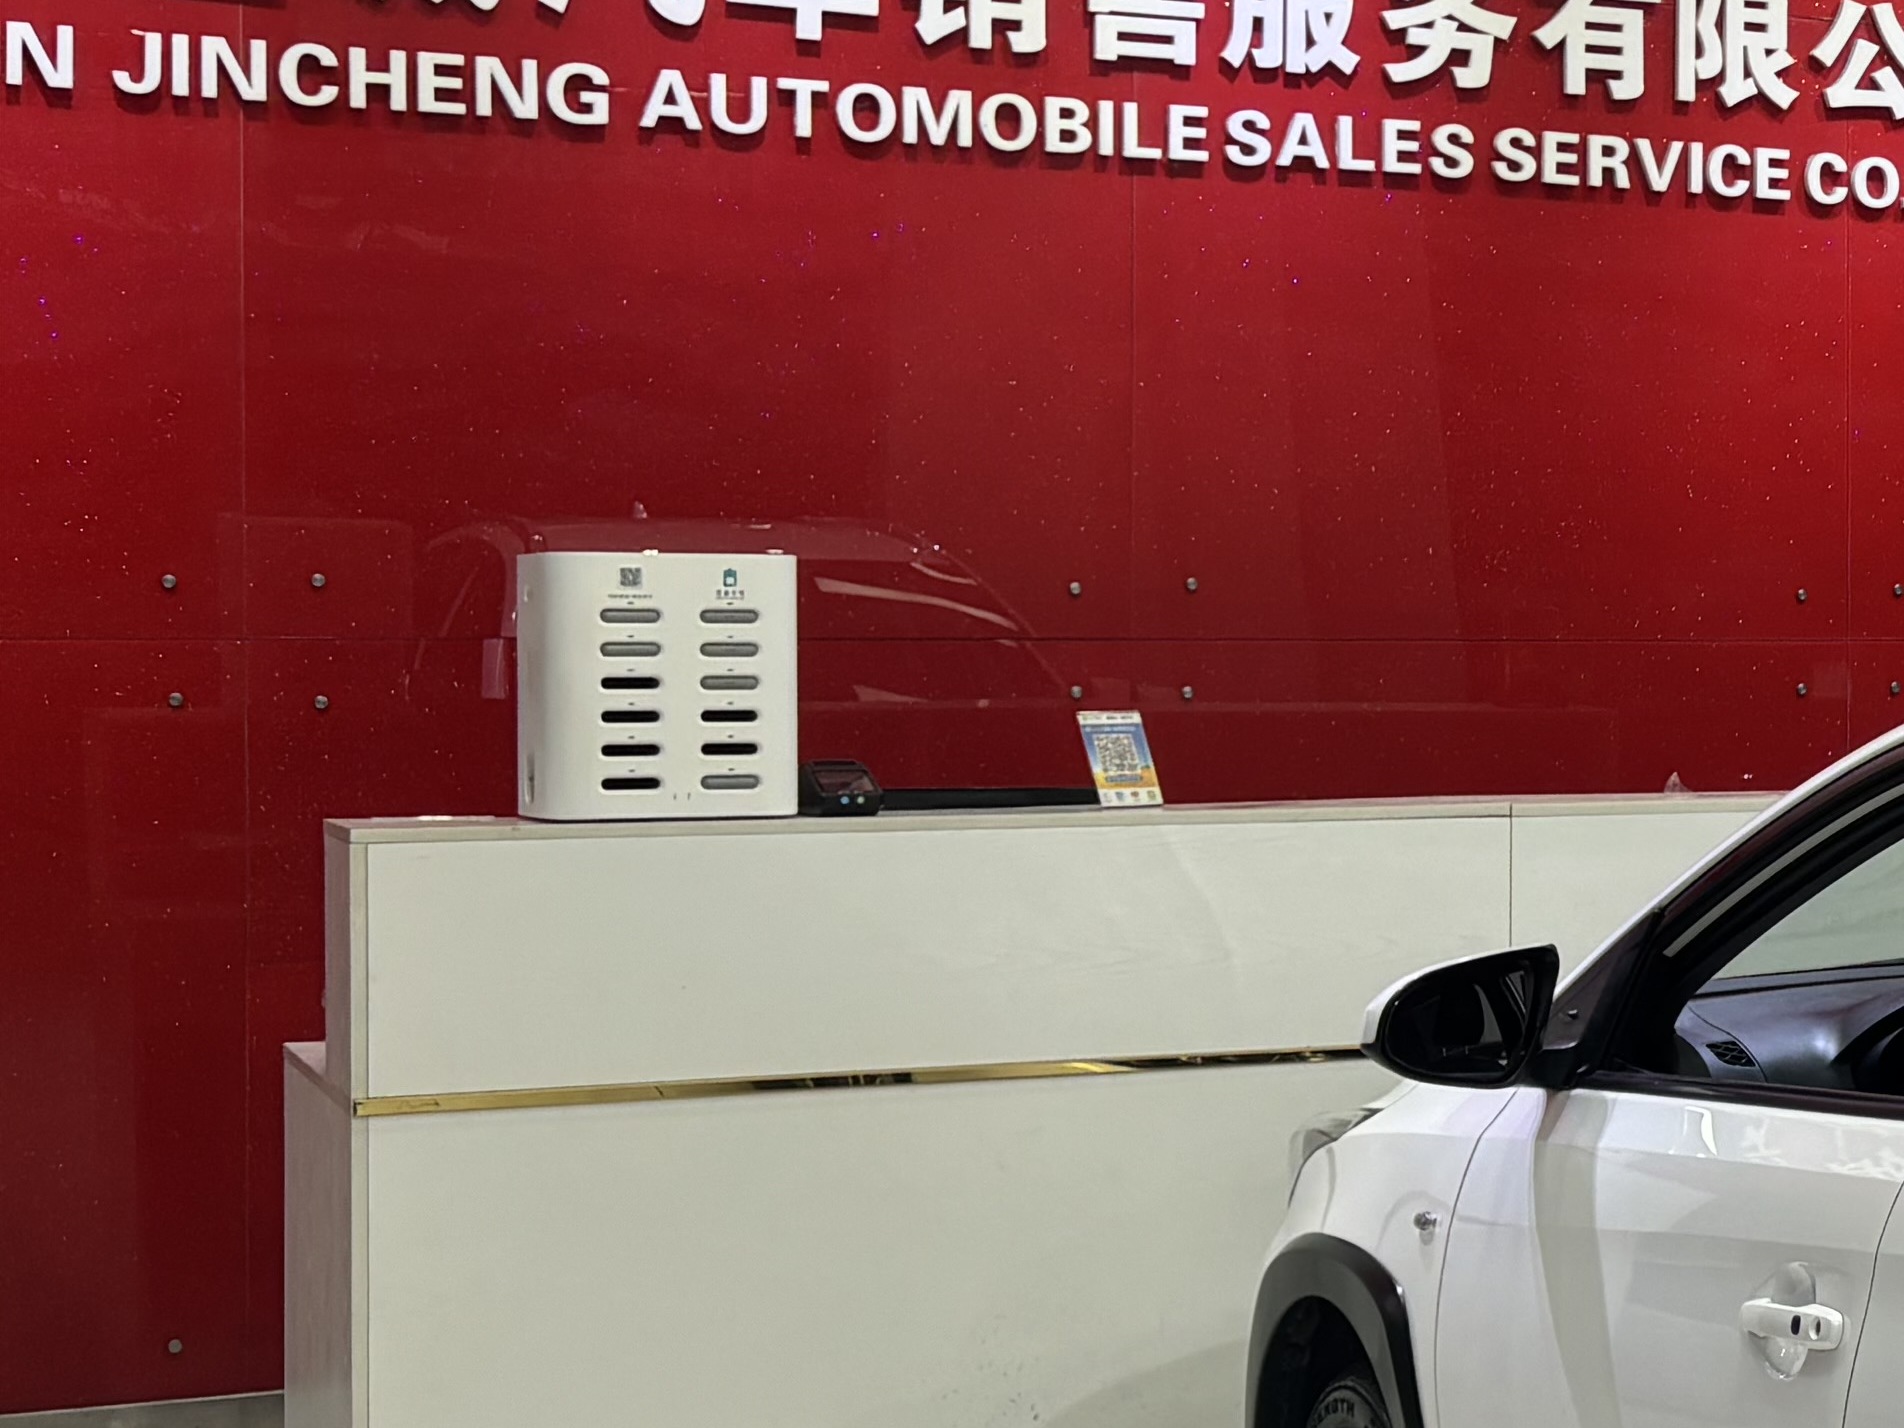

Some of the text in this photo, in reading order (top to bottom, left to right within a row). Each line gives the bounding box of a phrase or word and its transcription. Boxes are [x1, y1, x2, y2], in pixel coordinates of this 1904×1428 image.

[112, 27, 610, 127] JINCHENG
[639, 67, 1209, 163] AUTOMOBILE
[1225, 108, 1475, 180] SALES
[1491, 126, 1791, 202] SERVICE
